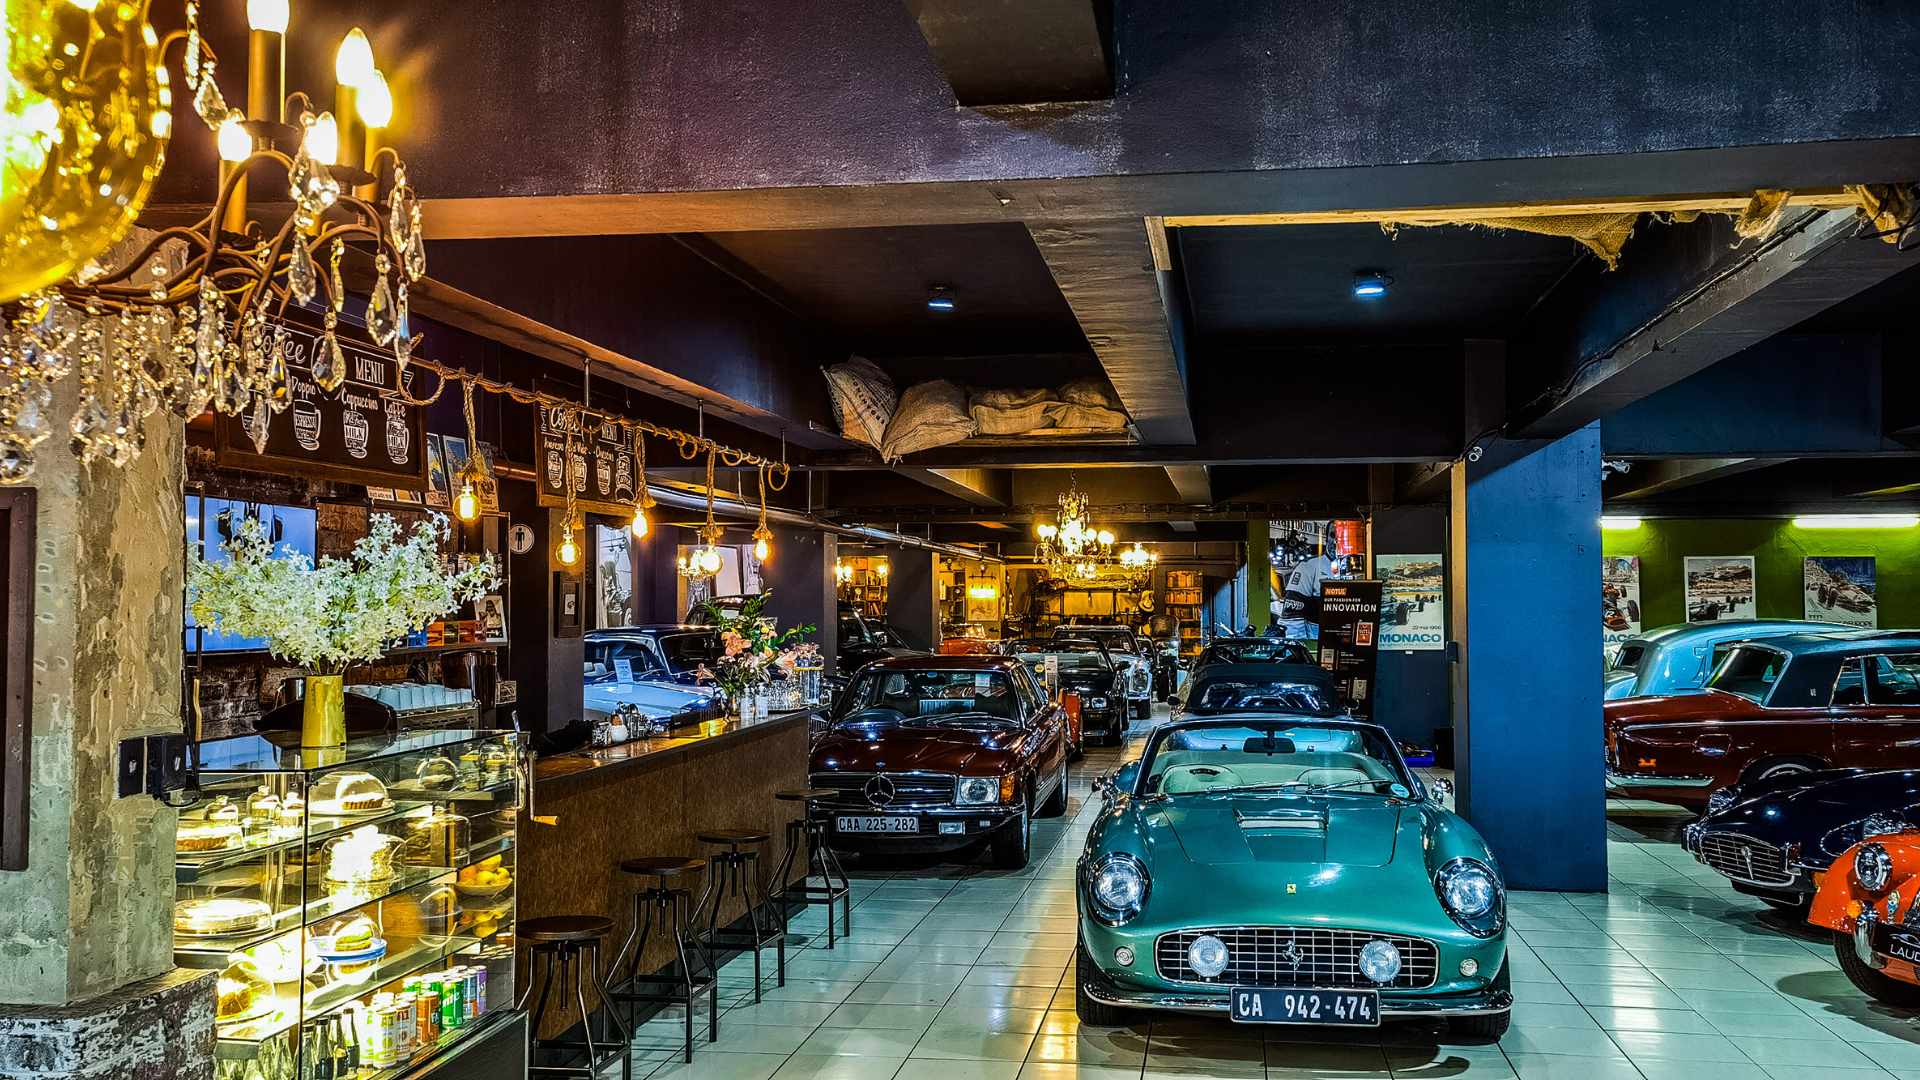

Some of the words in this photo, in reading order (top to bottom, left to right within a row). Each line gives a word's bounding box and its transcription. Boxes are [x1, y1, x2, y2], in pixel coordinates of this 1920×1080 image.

[355, 356, 384, 385] MENU
[291, 376, 316, 399] Doppio
[384, 399, 406, 417] Latte
[345, 427, 364, 440] MILK
[1323, 604, 1377, 612] INNOVATION
[1379, 634, 1442, 642] MONACO
[839, 818, 861, 831] CAA
[866, 818, 916, 831] 225-282
[1239, 993, 1263, 1017] CA
[1284, 994, 1371, 1020] 942-474
